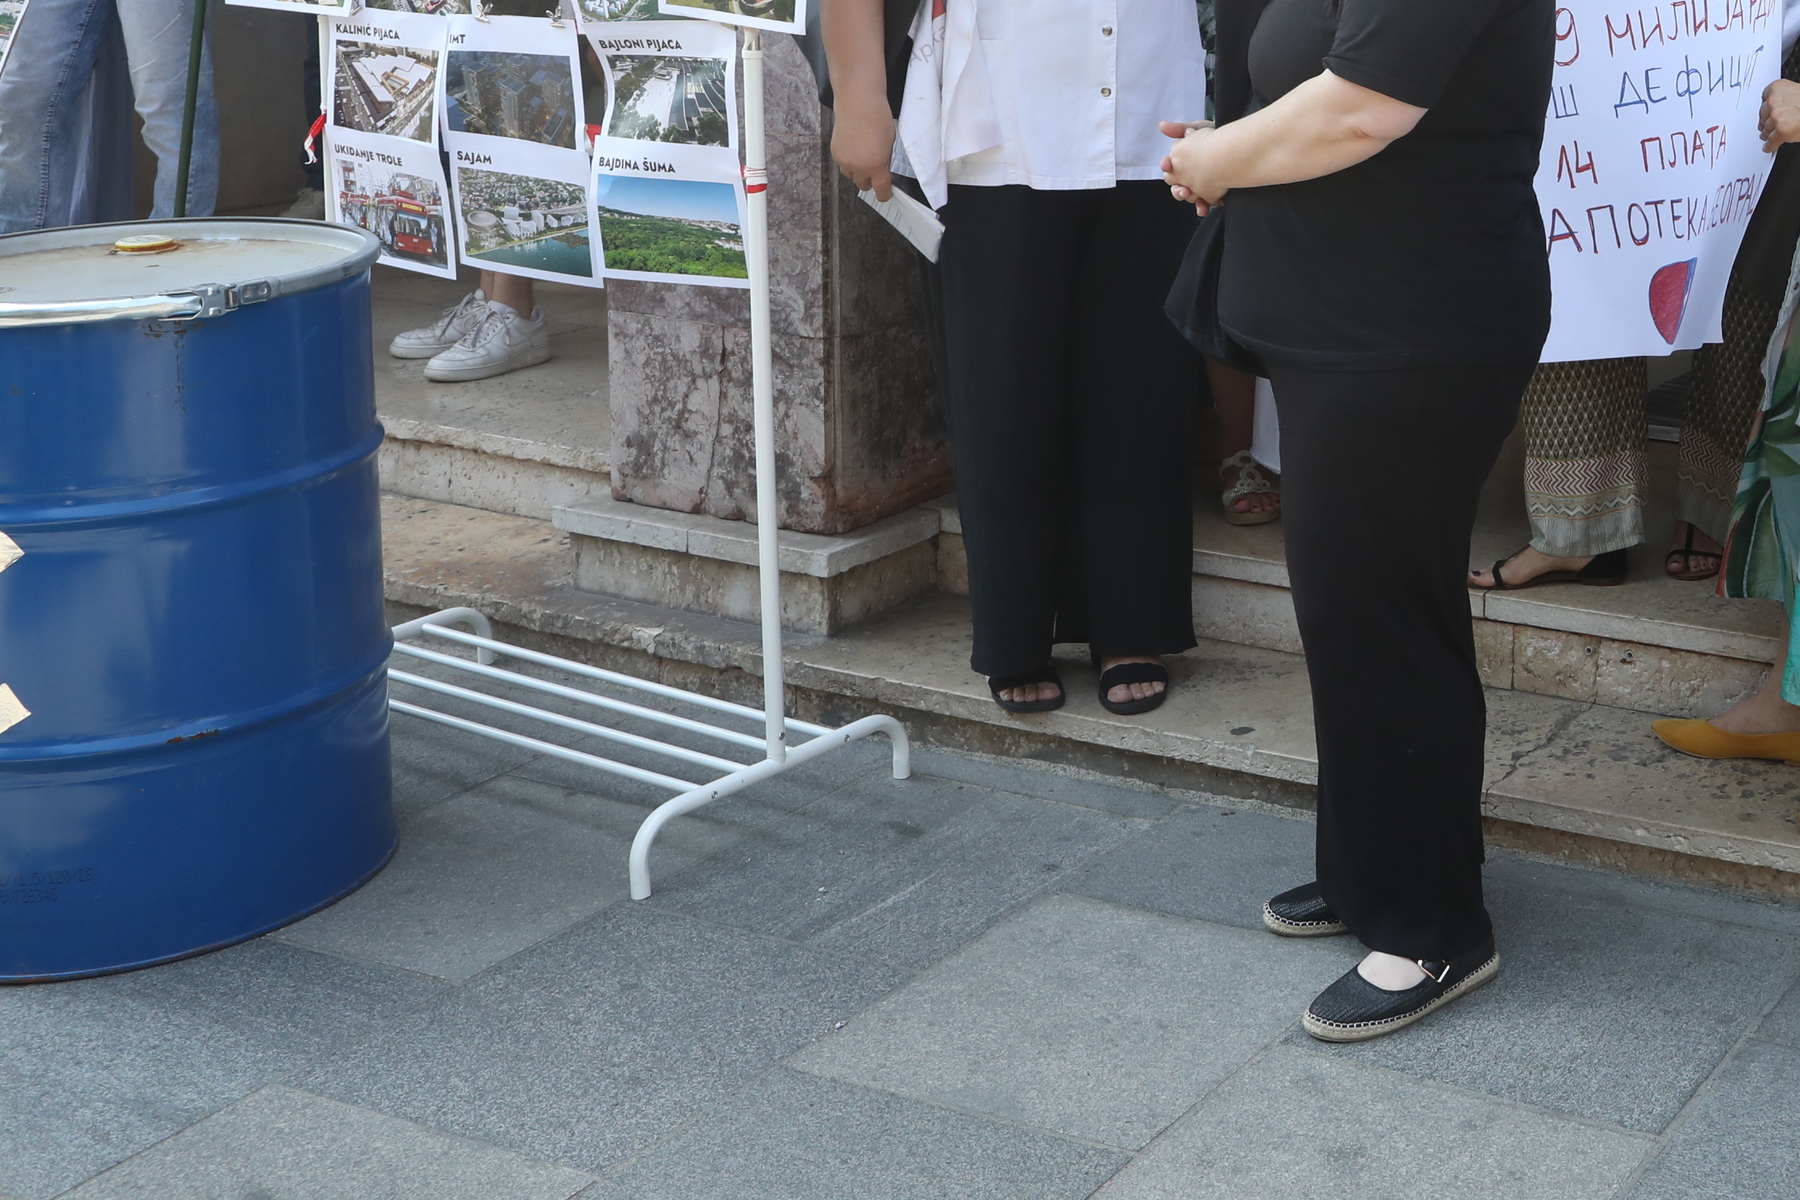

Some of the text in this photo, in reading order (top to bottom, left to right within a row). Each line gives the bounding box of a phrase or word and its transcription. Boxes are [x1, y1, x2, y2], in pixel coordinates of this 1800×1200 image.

[335, 23, 401, 41] KALINIĆ PIJACA
[449, 34, 466, 44] IMT
[599, 39, 682, 52] BAJLONI PIJACA
[1613, 44, 1764, 119] ДЕФИЦИТ
[334, 144, 403, 167] UKIDANJE TROLE
[456, 150, 493, 165] SAJAM
[1557, 124, 1727, 189] 14 ПЛАТА
[598, 156, 676, 174] BAJDINA ŠUMA
[1548, 195, 1708, 259] АПОТЕКА
